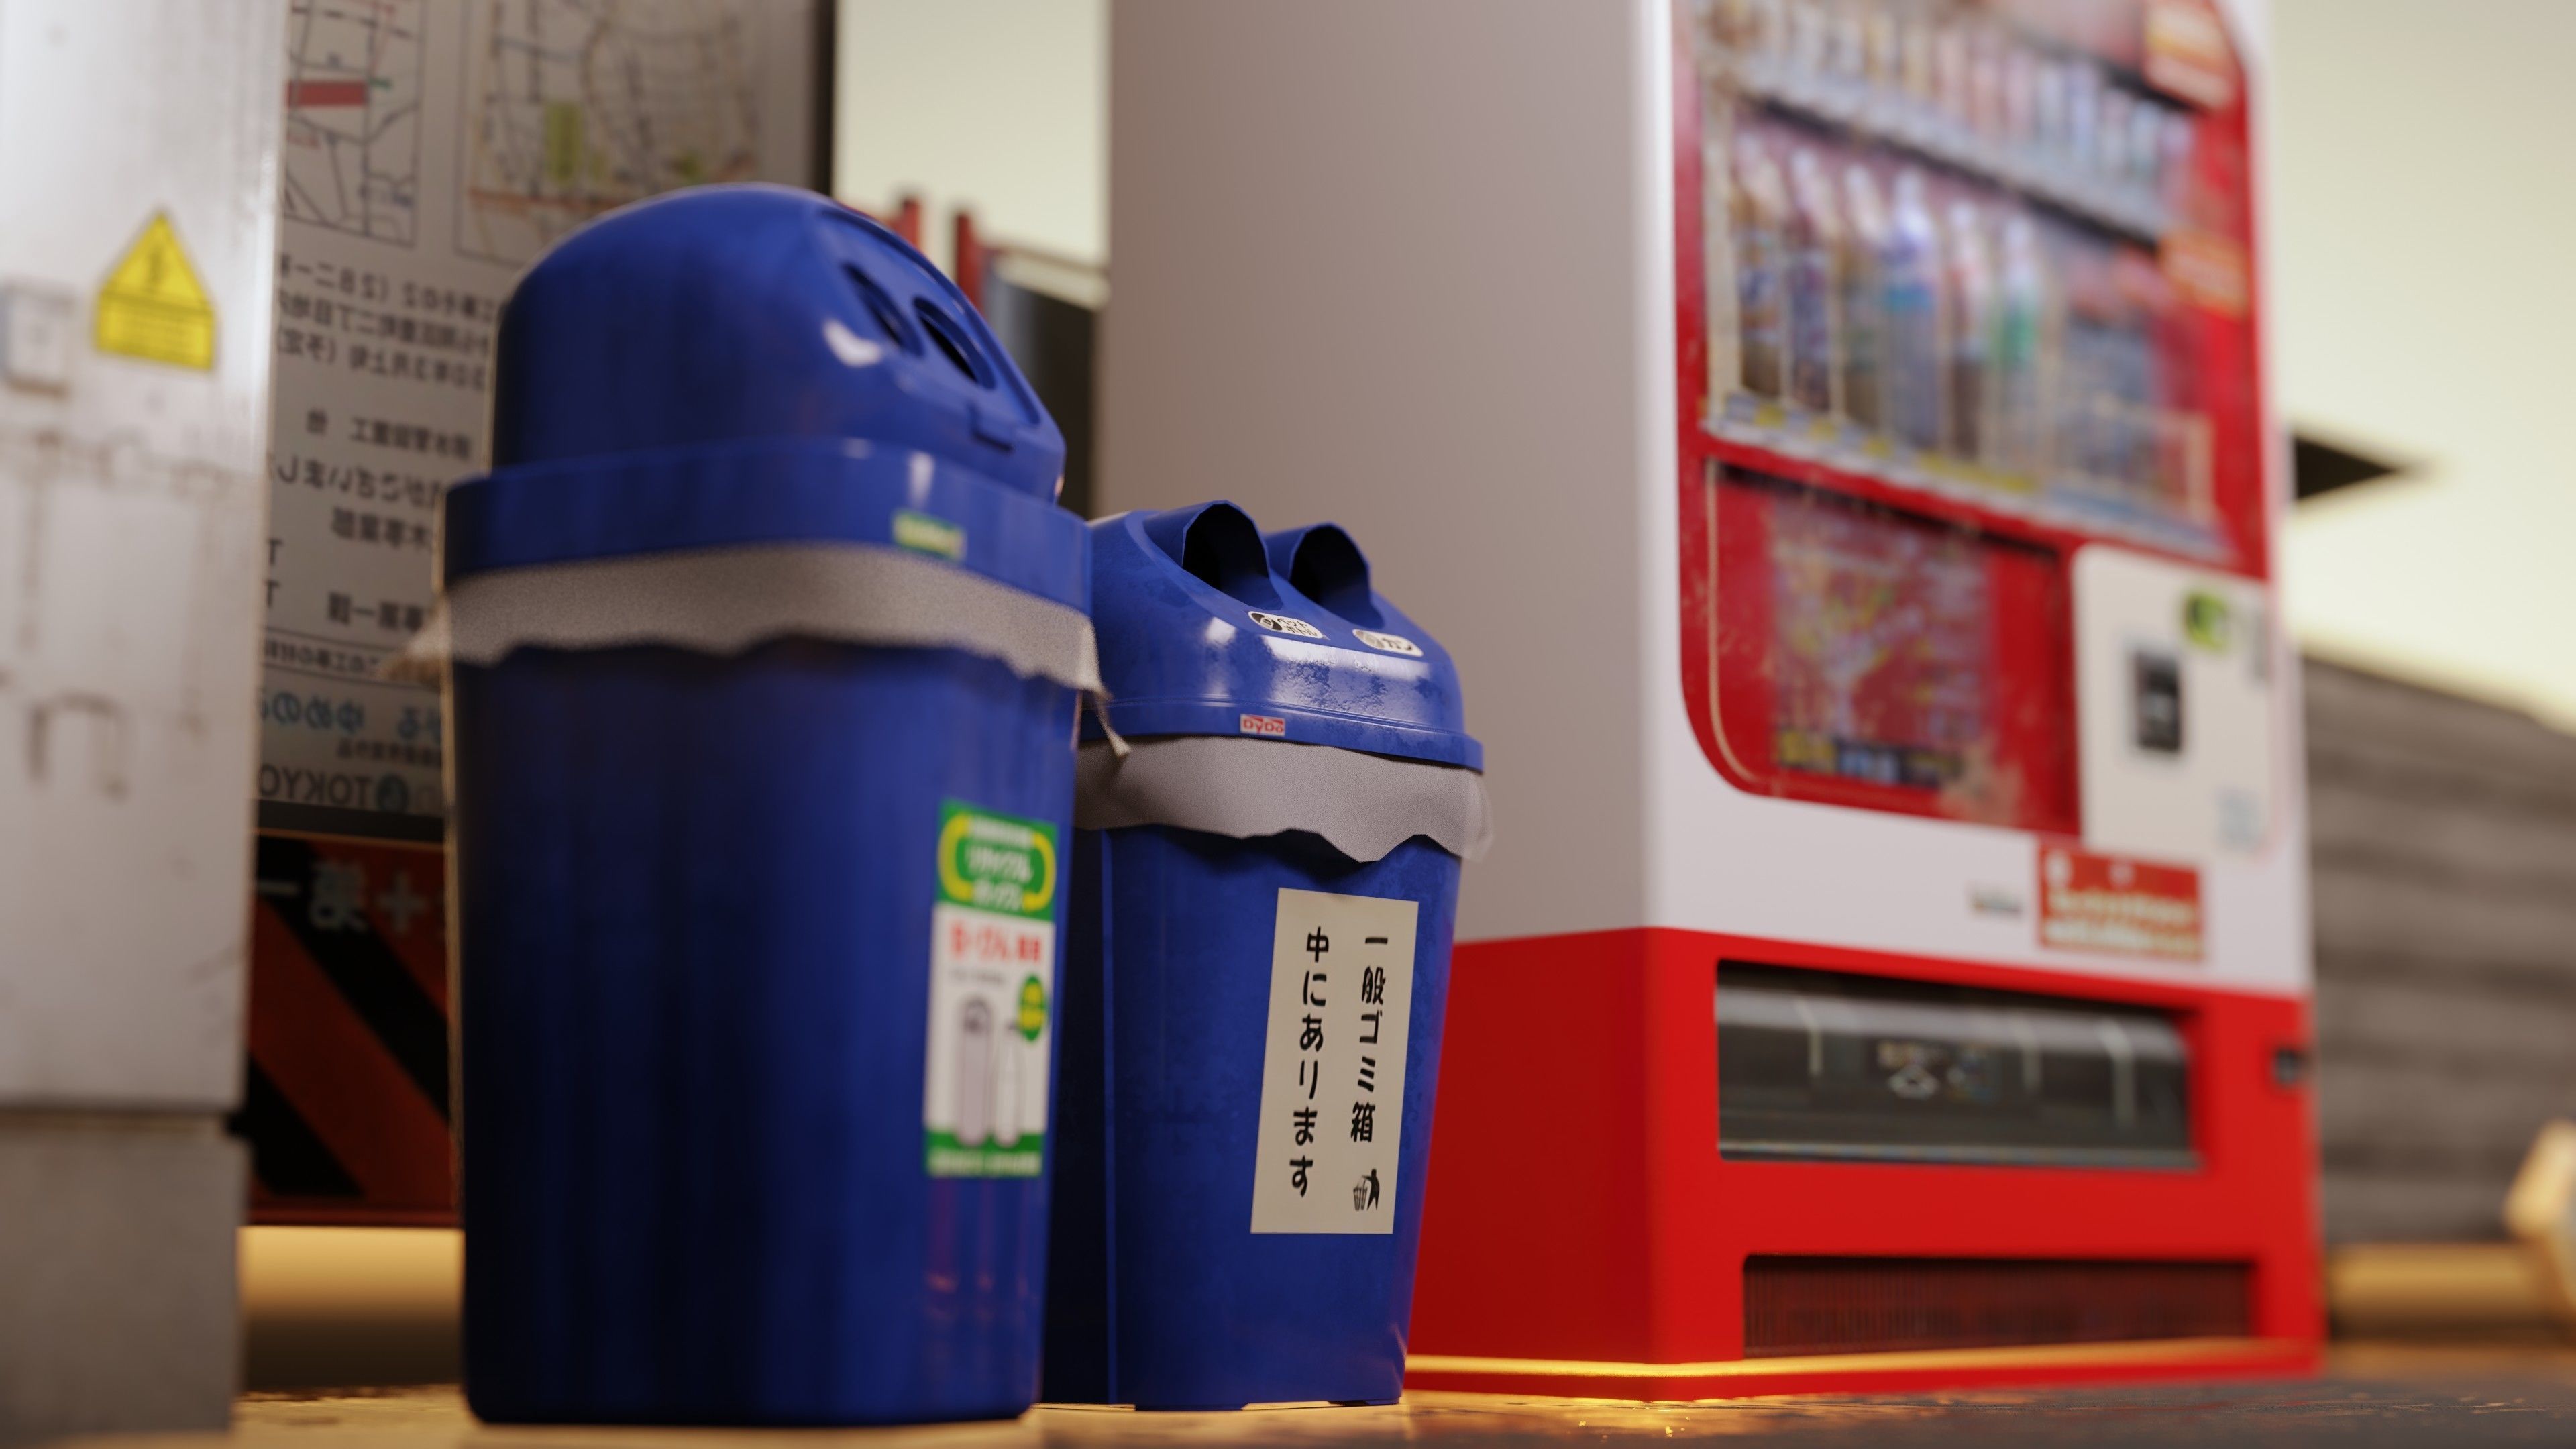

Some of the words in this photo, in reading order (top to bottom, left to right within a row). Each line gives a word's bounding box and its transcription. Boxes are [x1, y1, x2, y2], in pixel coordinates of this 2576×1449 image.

[1243, 716, 1283, 735] DyDo
[1289, 926, 1330, 1198] 中にあります
[1350, 936, 1389, 1143] 一般ゴミ箱
